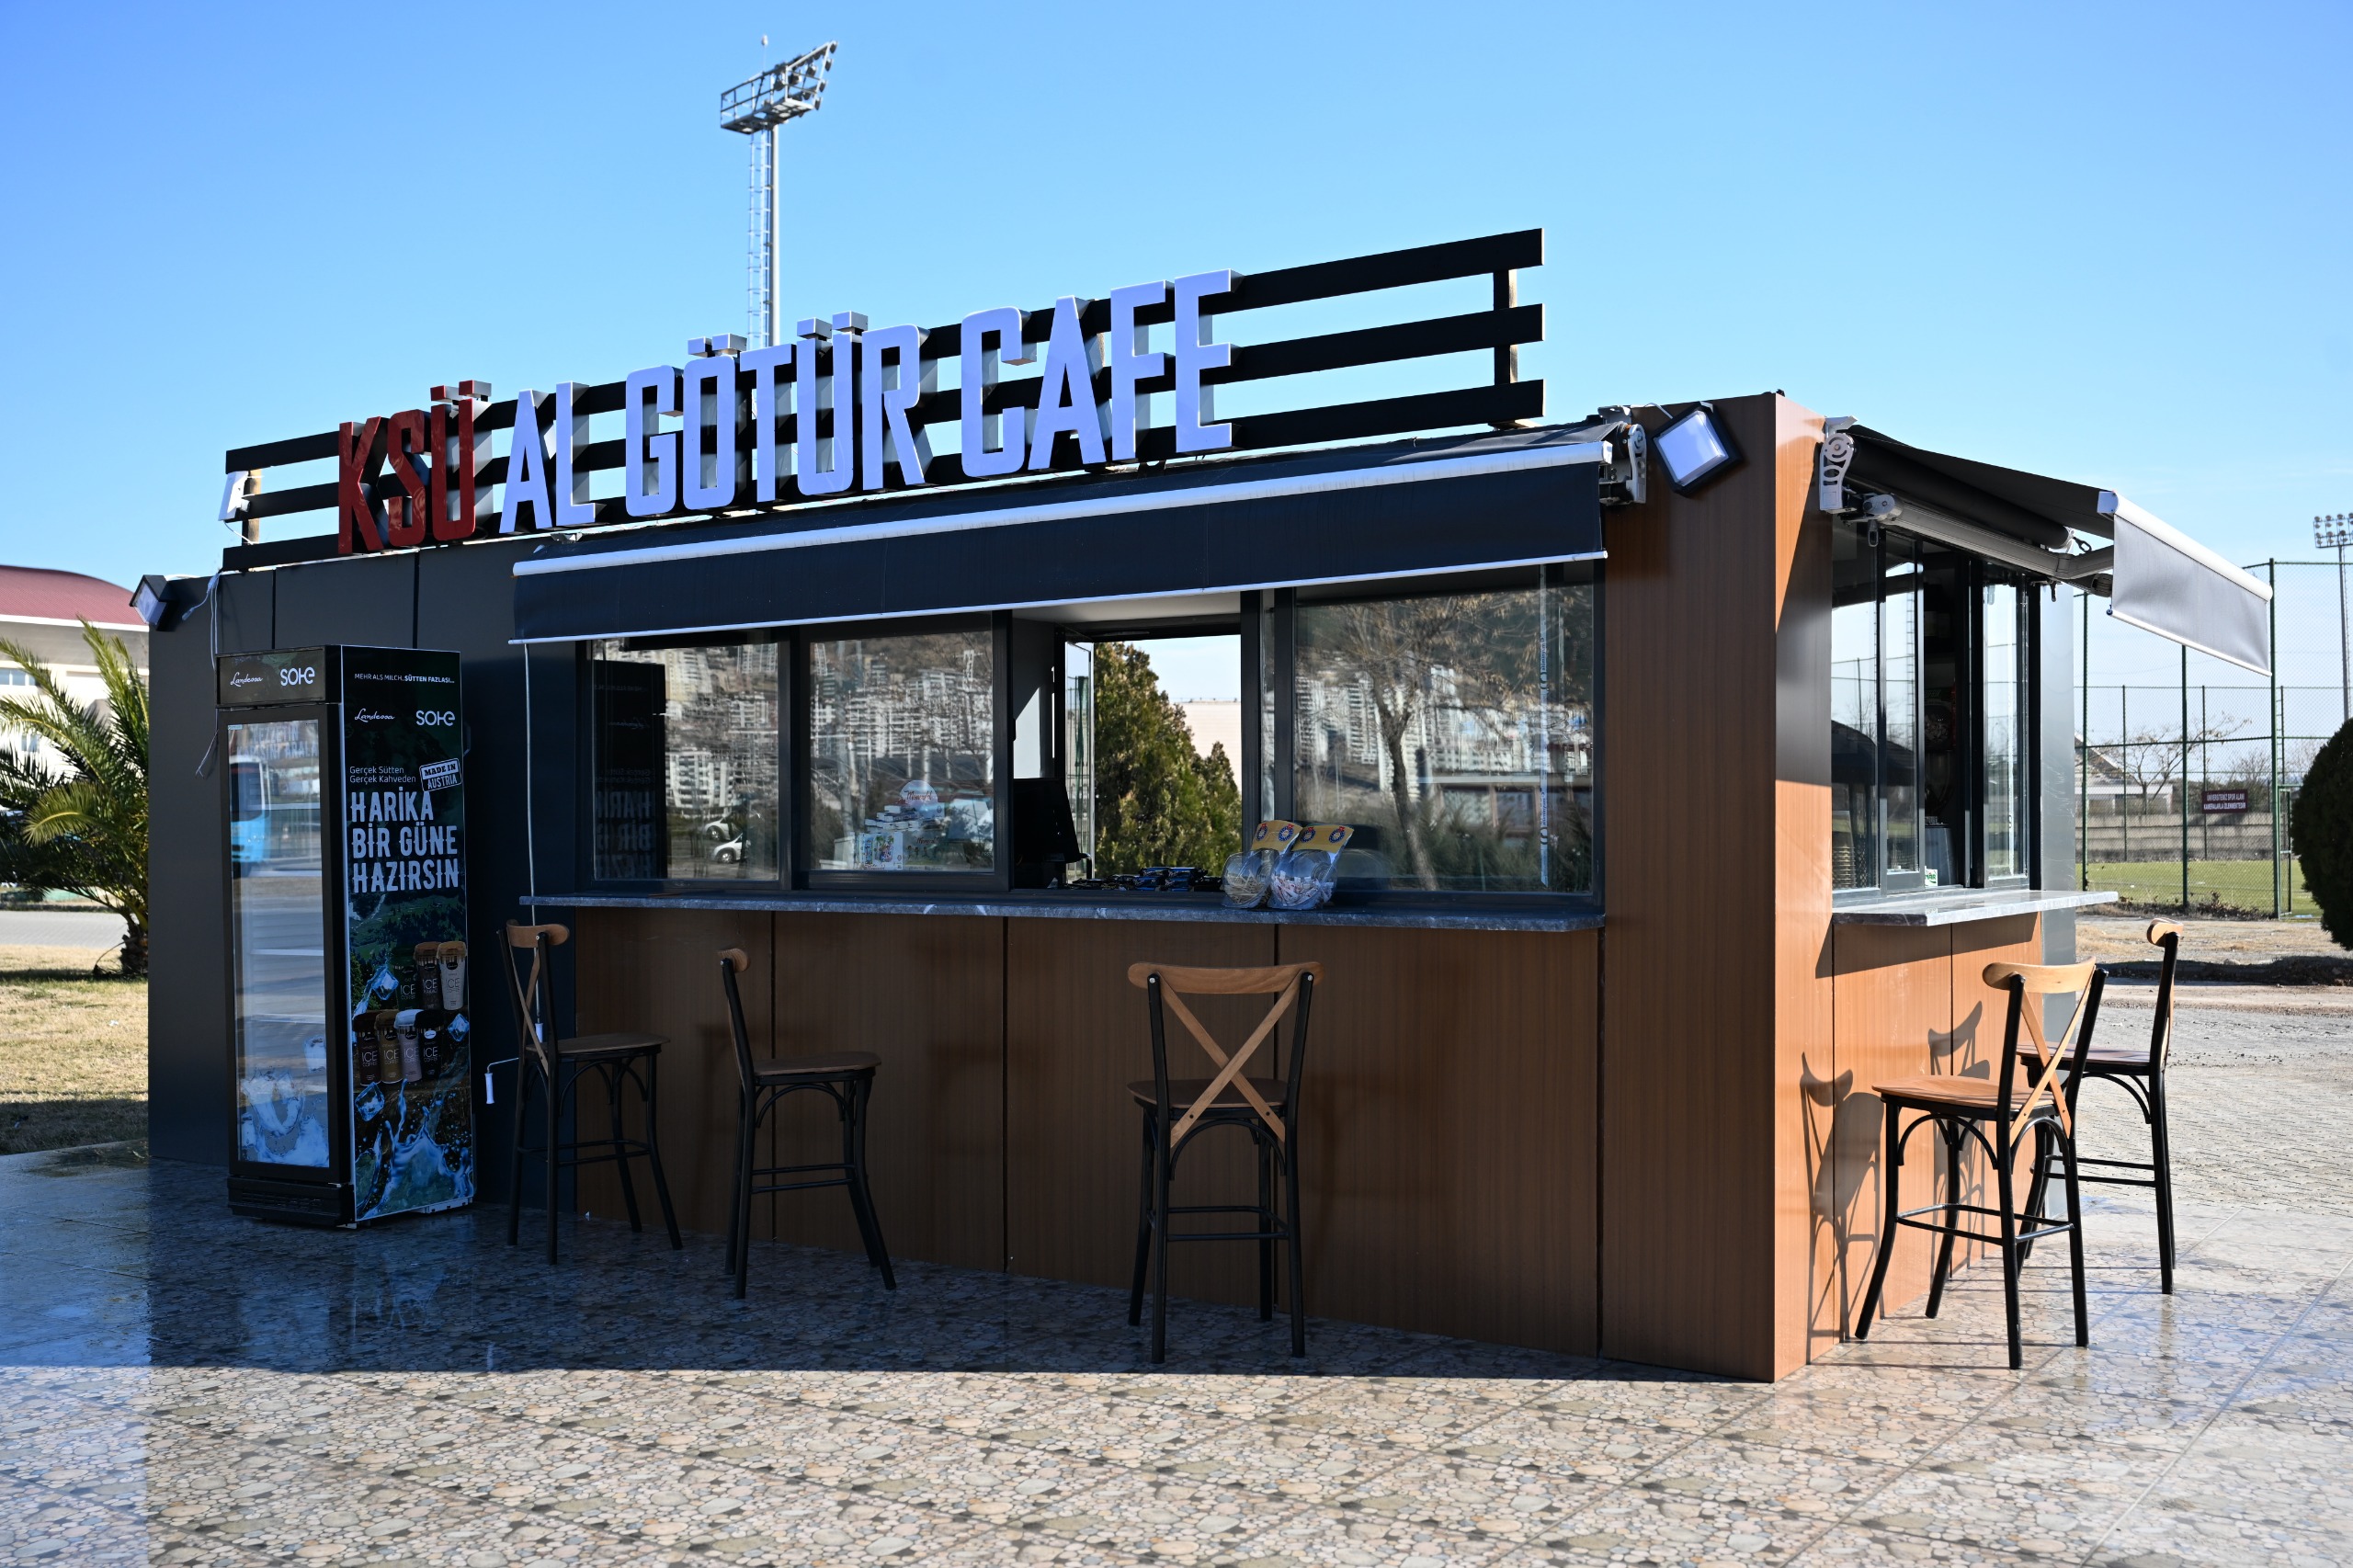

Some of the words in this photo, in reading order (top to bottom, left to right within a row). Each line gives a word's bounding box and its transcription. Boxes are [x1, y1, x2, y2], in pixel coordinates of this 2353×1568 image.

[338, 380, 485, 554] KSÜ
[499, 381, 596, 534] AL
[625, 311, 926, 517] GÖTÜR
[961, 267, 1234, 478] CAFE
[354, 708, 395, 723] Landessa
[349, 766, 378, 776] Gerçek
[379, 766, 404, 774] Sütten
[424, 766, 447, 777] MADE
[448, 763, 456, 771] IN
[349, 775, 378, 785] Gerçek
[379, 775, 416, 783] Kahveden
[427, 774, 458, 790] AUSTRIA
[350, 786, 434, 823] HARİKA
[351, 823, 392, 859] BİR
[399, 821, 458, 857] GÜNE
[352, 858, 460, 893] HAZIRSIN
[401, 984, 416, 995] ICE
[423, 978, 438, 990] ICE
[446, 978, 460, 989] ICE
[361, 1051, 378, 1062] ICE
[383, 1049, 400, 1060] ICE
[404, 1047, 419, 1058] ICE
[423, 1046, 438, 1058] ICE
